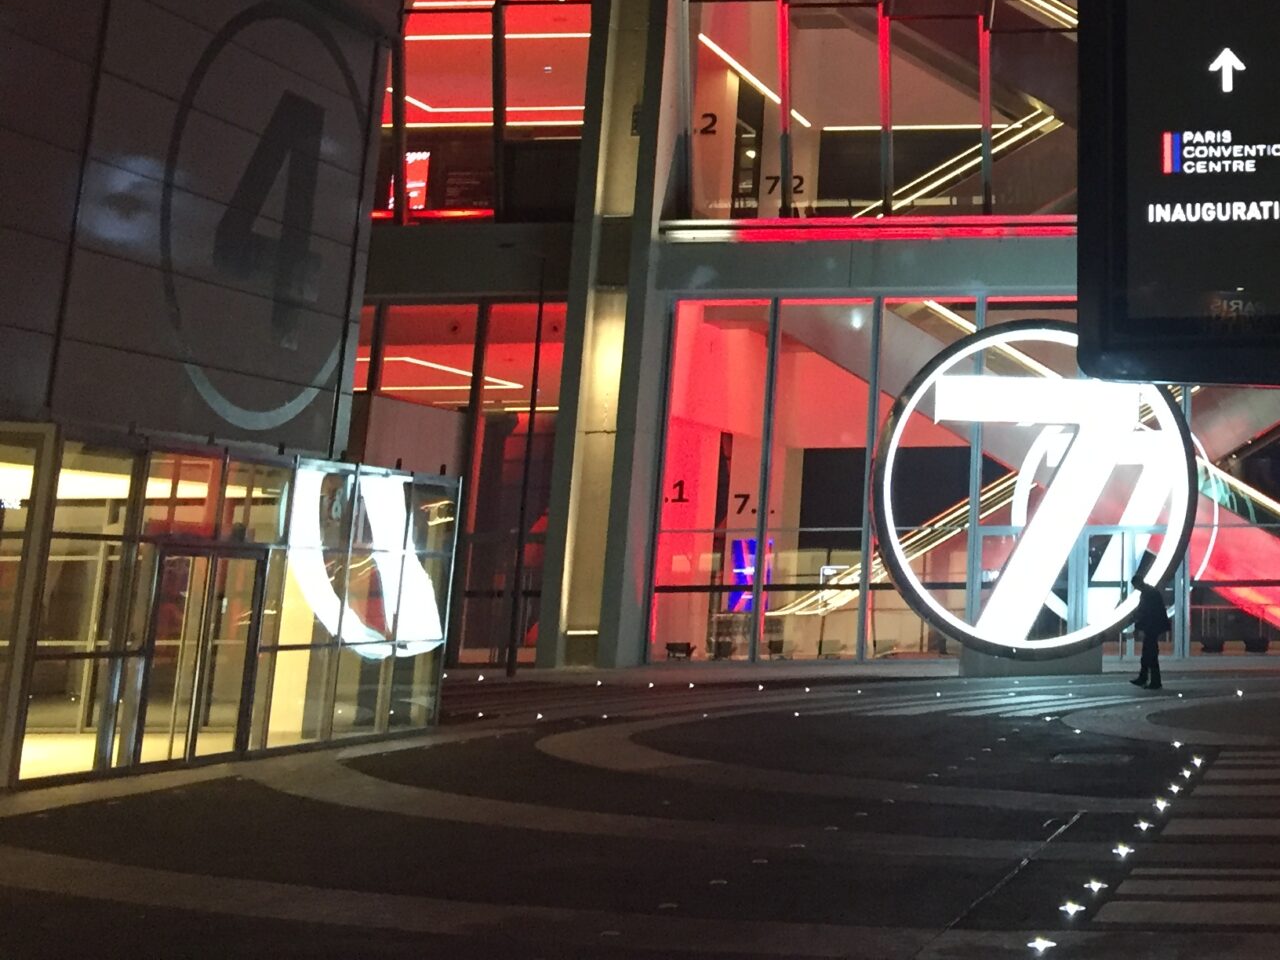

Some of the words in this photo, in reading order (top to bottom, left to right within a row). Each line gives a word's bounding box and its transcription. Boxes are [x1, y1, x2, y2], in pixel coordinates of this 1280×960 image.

[1182, 159, 1256, 174] CENTRE
[1183, 129, 1232, 144] PARIS
[212, 90, 325, 351] 4
[934, 375, 1140, 642] 7
